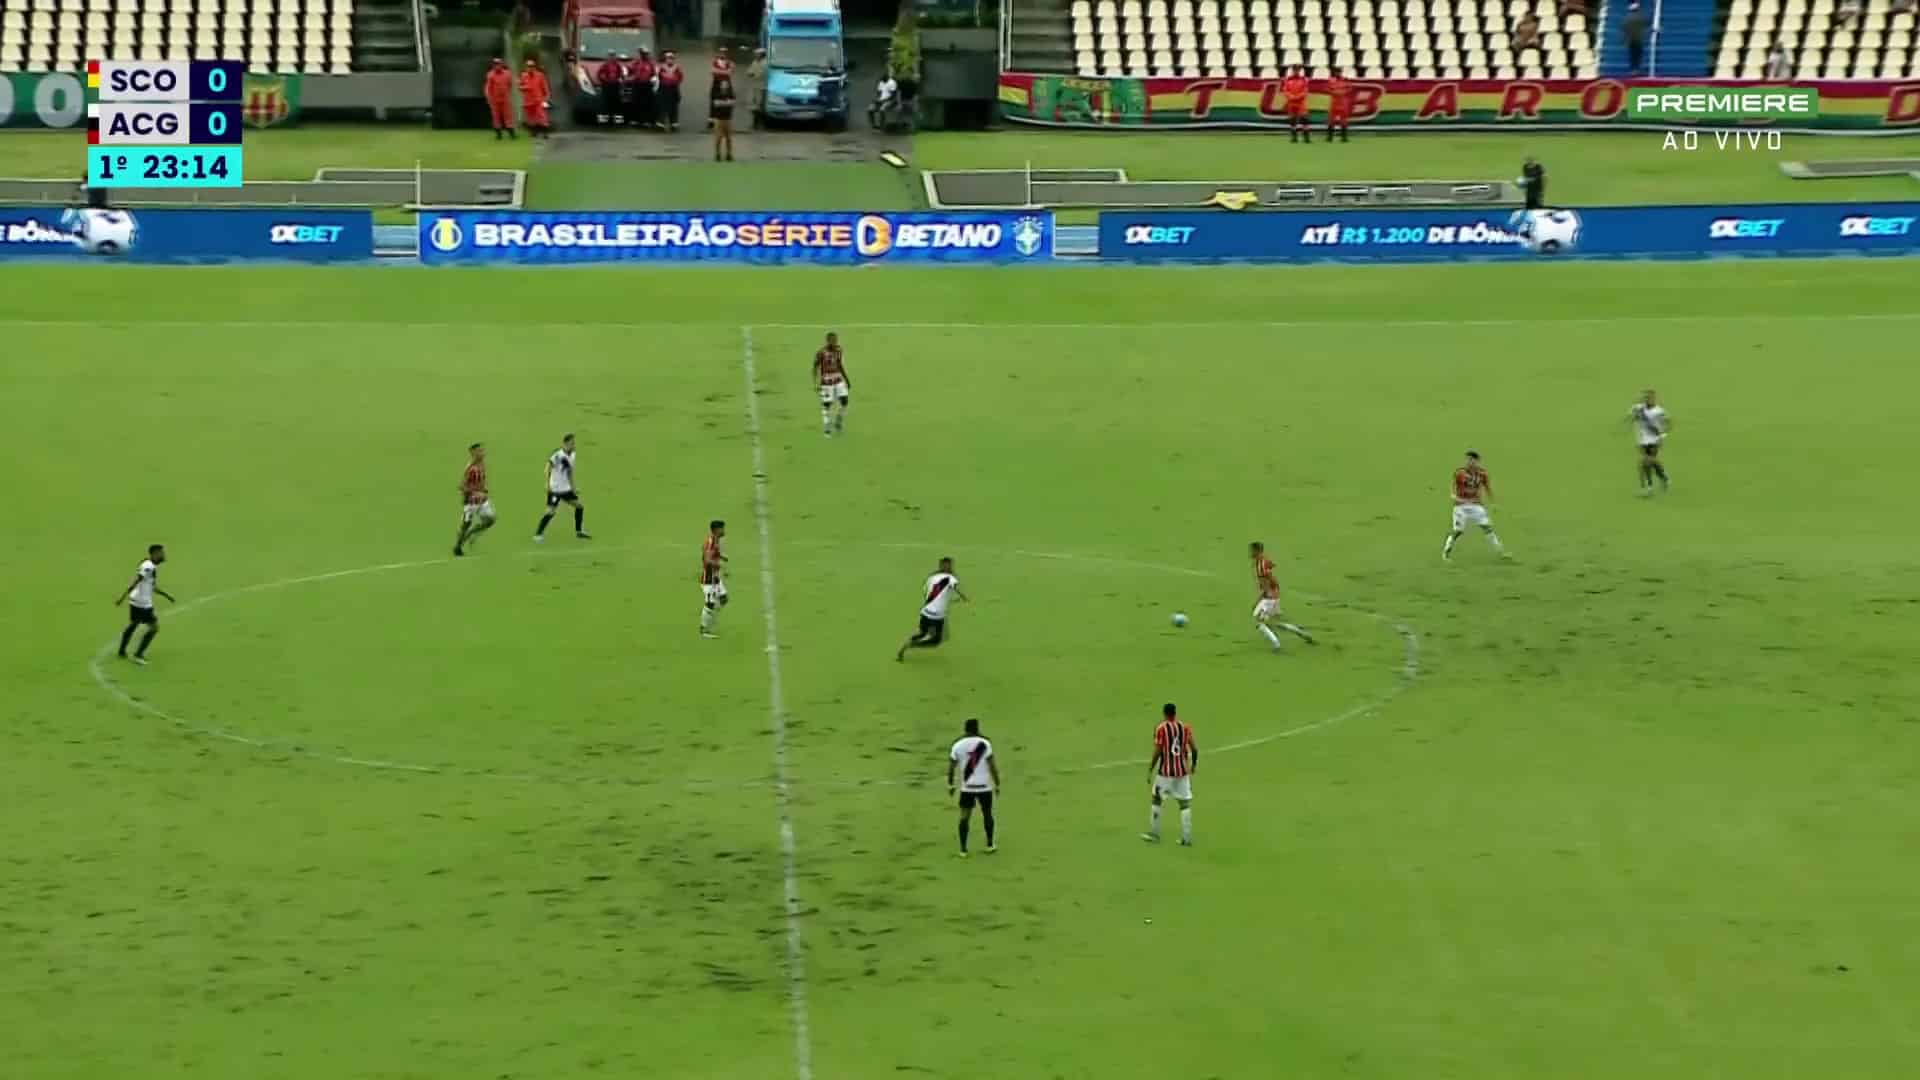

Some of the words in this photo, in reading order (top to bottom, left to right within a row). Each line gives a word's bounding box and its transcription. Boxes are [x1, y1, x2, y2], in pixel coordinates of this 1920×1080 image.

[895, 223, 1002, 248] BETANO
[1300, 223, 1340, 245] ATÉ
[1341, 226, 1368, 244] R$
[1371, 226, 1425, 244] 1.200
[1426, 225, 1457, 244] DE
